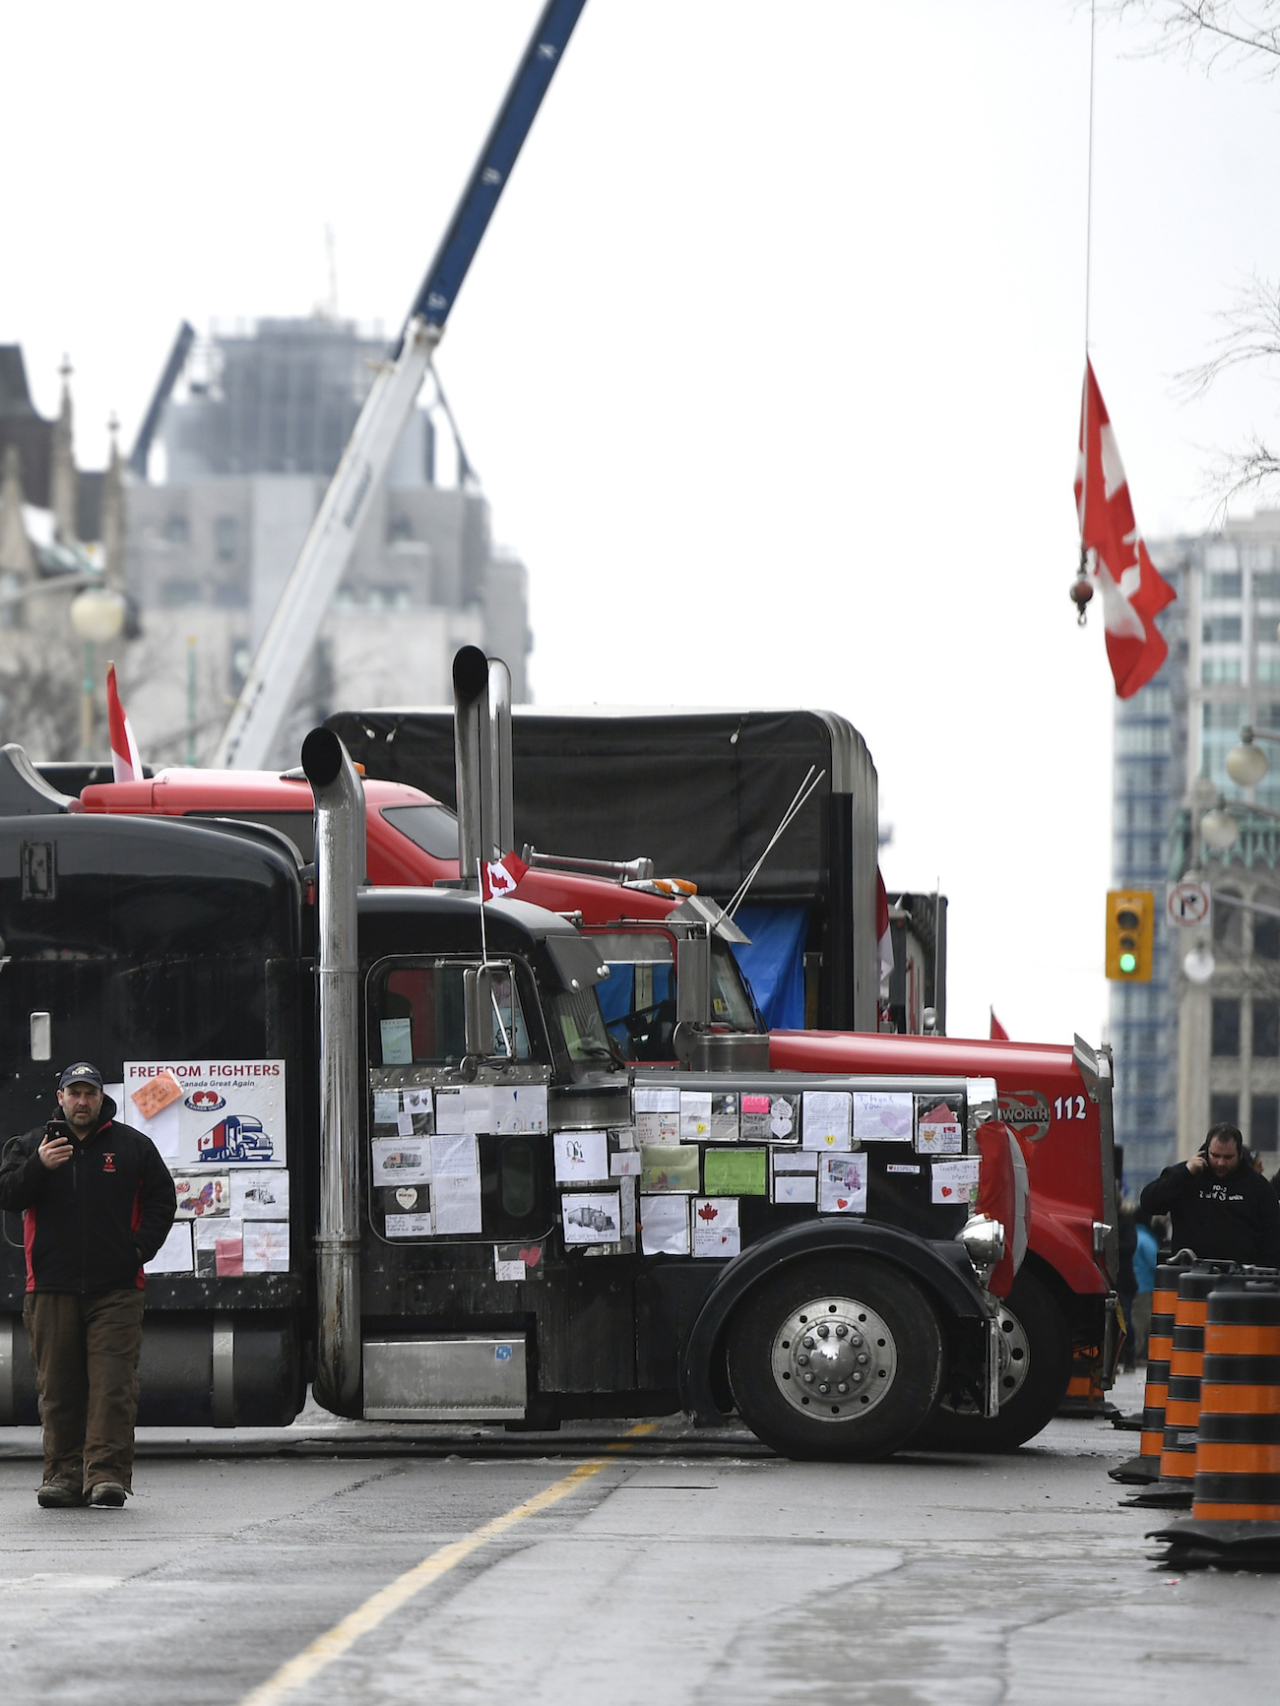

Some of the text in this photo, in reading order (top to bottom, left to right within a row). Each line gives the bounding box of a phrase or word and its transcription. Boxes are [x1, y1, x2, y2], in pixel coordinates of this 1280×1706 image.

[209, 1065, 280, 1076] FIGHTERS
[180, 1080, 208, 1088] Canada
[232, 1080, 255, 1088] Again
[186, 1102, 207, 1110] CANADA
[1054, 1095, 1087, 1120] 112
[999, 1109, 1048, 1120] WORTH
